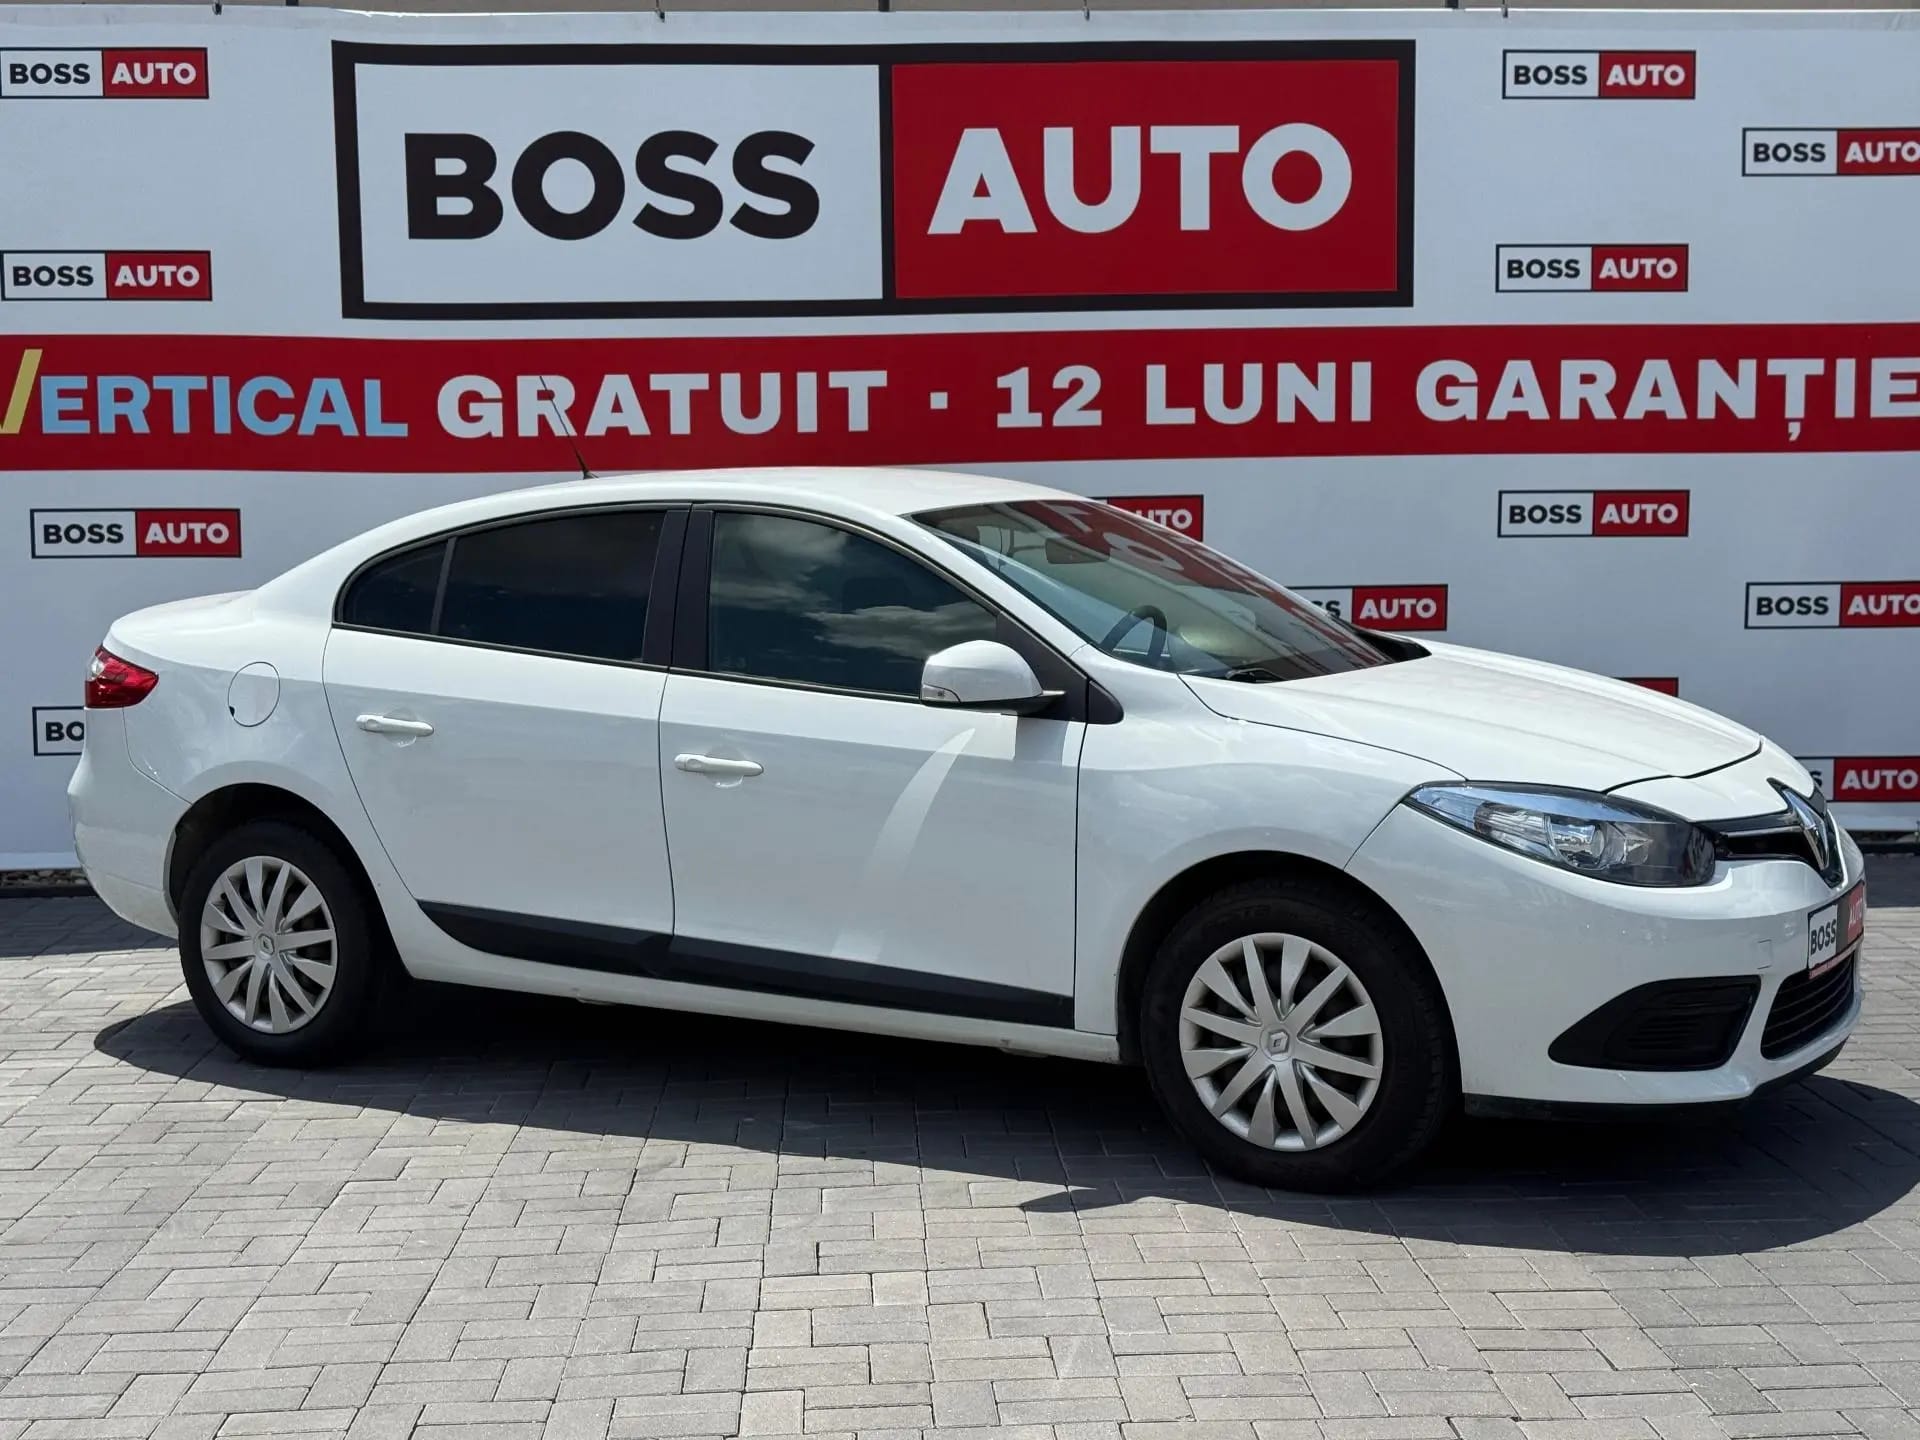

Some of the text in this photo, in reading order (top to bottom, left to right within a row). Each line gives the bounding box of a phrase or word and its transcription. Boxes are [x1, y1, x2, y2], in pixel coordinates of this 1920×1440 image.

[10, 63, 196, 84] BOSS AUTO
[1514, 65, 1684, 85] BOSS AUTO
[1754, 142, 1920, 162] BOSS AUTO
[405, 123, 1352, 240] BOSS AUTO
[13, 265, 199, 286] BOSS AUTO
[1508, 258, 1677, 278] BOSS AUTO
[438, 371, 887, 438] GRATUIT
[997, 365, 1101, 427] 12
[1147, 362, 1371, 424] LUNI
[1416, 358, 1920, 440] GARANȚIE
[1509, 504, 1678, 523] BOSS AUTO
[44, 523, 229, 544] BOSS AUTO
[1360, 599, 1436, 618] AUTO
[1757, 595, 1920, 615] BOSS AUTO
[46, 722, 83, 741] BO
[1842, 770, 1918, 789] AUTO
[1811, 919, 1836, 955] BOSS
